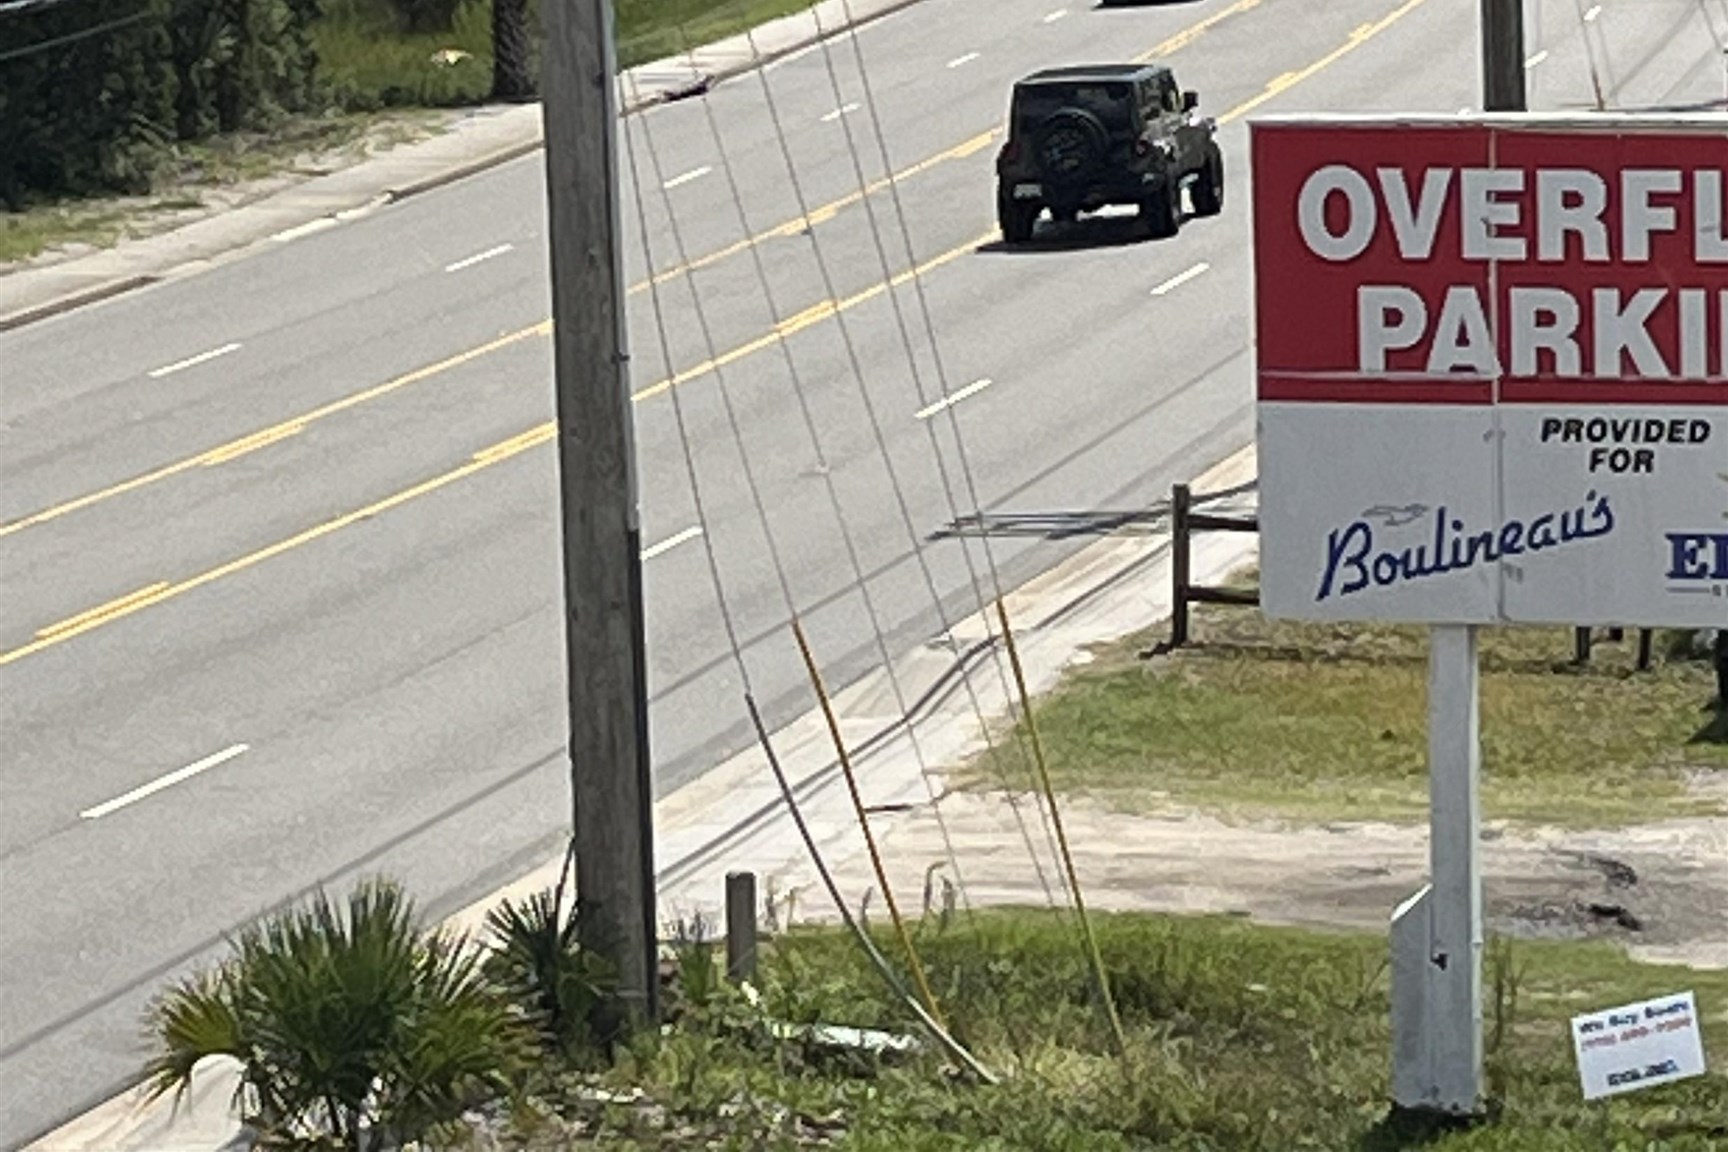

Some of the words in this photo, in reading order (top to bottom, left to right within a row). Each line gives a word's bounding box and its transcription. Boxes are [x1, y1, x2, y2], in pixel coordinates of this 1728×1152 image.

[1357, 285, 1728, 380] PARKI
[1541, 418, 1711, 443] PROVIDED
[1589, 448, 1654, 473] FOR
[1315, 489, 1614, 602] Boulineau's
